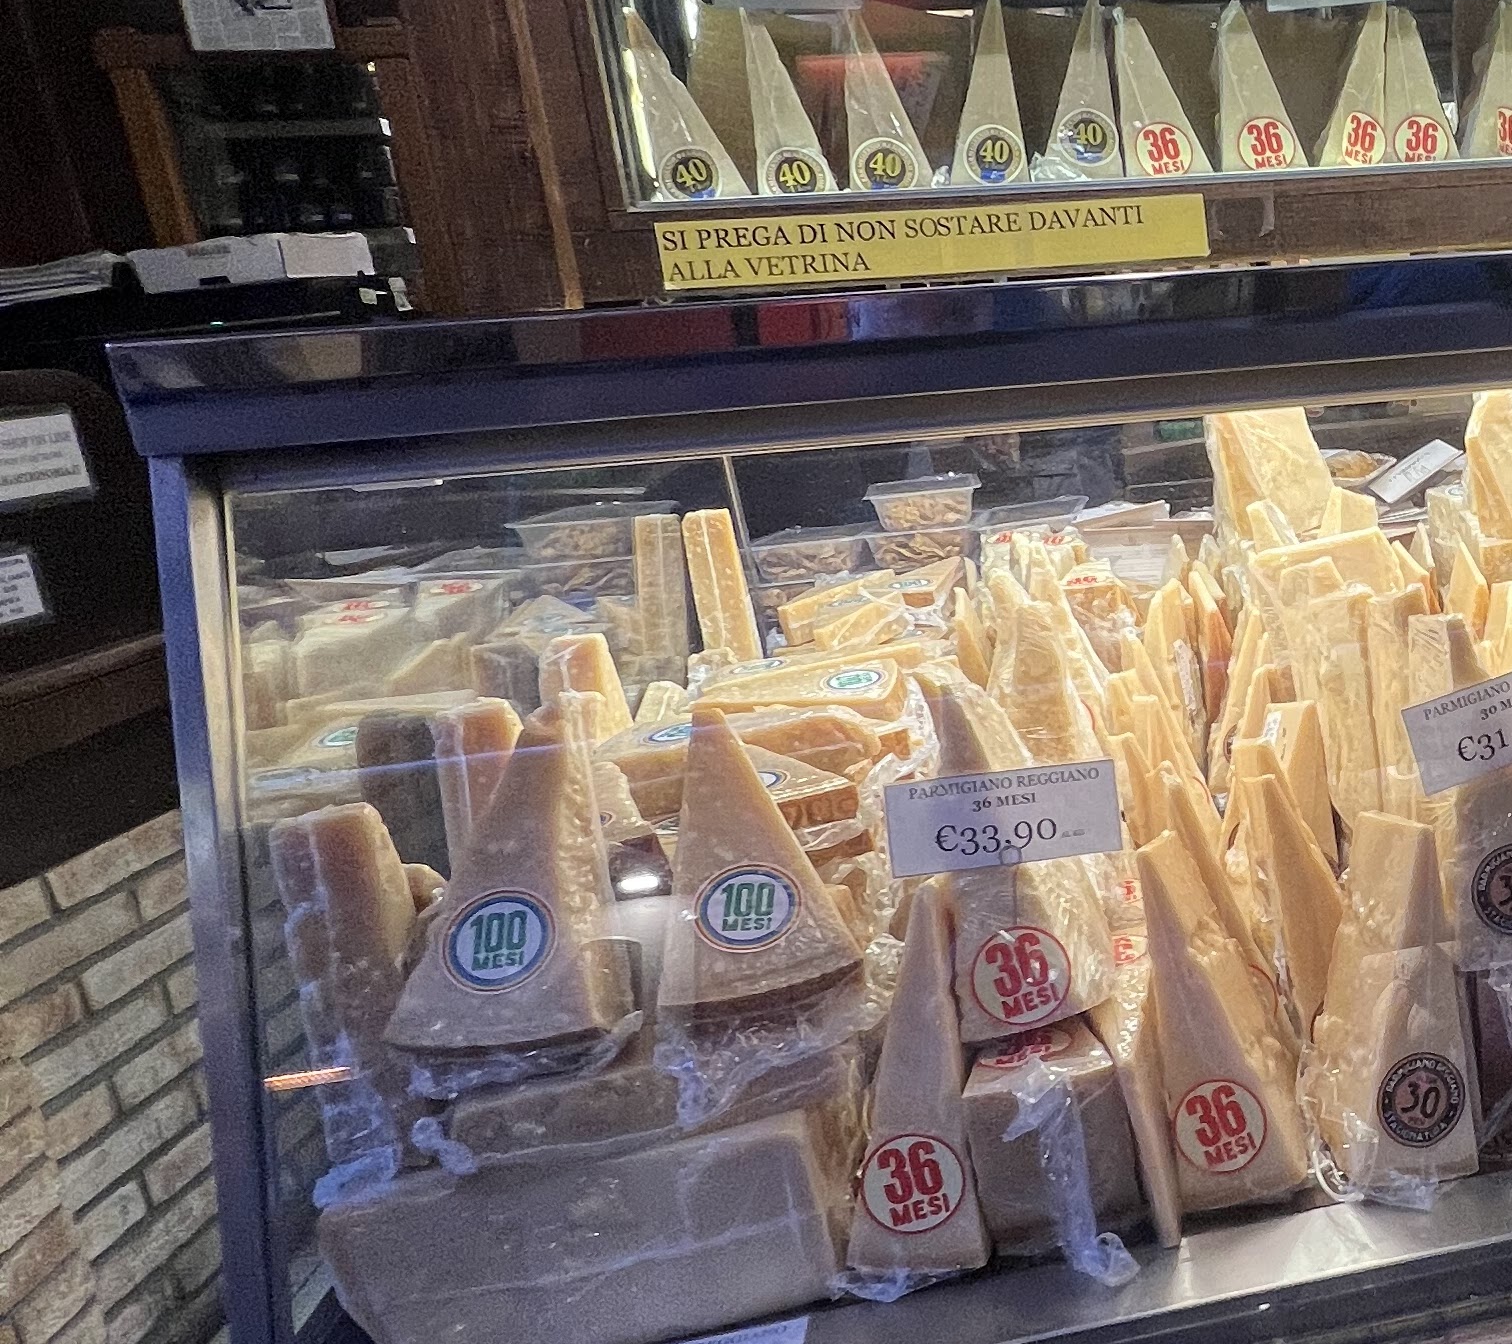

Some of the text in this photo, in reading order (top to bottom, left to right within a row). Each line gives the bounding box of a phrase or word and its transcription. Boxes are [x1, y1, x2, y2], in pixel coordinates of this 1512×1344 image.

[1076, 122, 1103, 146] 40
[1143, 127, 1181, 163] 36
[1247, 121, 1284, 156] 36
[1348, 115, 1377, 153] 36
[1406, 120, 1438, 154] 36
[869, 151, 902, 177] 40
[979, 139, 1011, 164] 40
[1254, 155, 1287, 169] MESI
[1345, 147, 1372, 165] MESI
[676, 158, 708, 188] 40
[778, 160, 811, 187] 40
[1151, 162, 1185, 176] MESI
[662, 205, 1145, 252] SI PREGA DI NON SOSTARE DAVANTI
[668, 252, 871, 282] ALLA VETRINA
[1424, 681, 1511, 720] PARMIGIANO
[1480, 705, 1498, 720] 30
[909, 767, 1100, 800] PARMIGIANO REGGIANO
[972, 792, 1037, 813] 36 MESI
[935, 818, 1057, 856] €33,90
[720, 882, 775, 917] 100
[470, 909, 528, 955] 100
[722, 916, 772, 932] MESI
[471, 951, 524, 972] MESI
[985, 932, 1049, 997] 36
[1001, 984, 1060, 1019] MESI
[1186, 1085, 1247, 1147] 36
[1401, 1081, 1440, 1118] 30
[1203, 1133, 1258, 1166] MESI
[877, 1140, 944, 1204] 36
[888, 1193, 951, 1228] MESI
